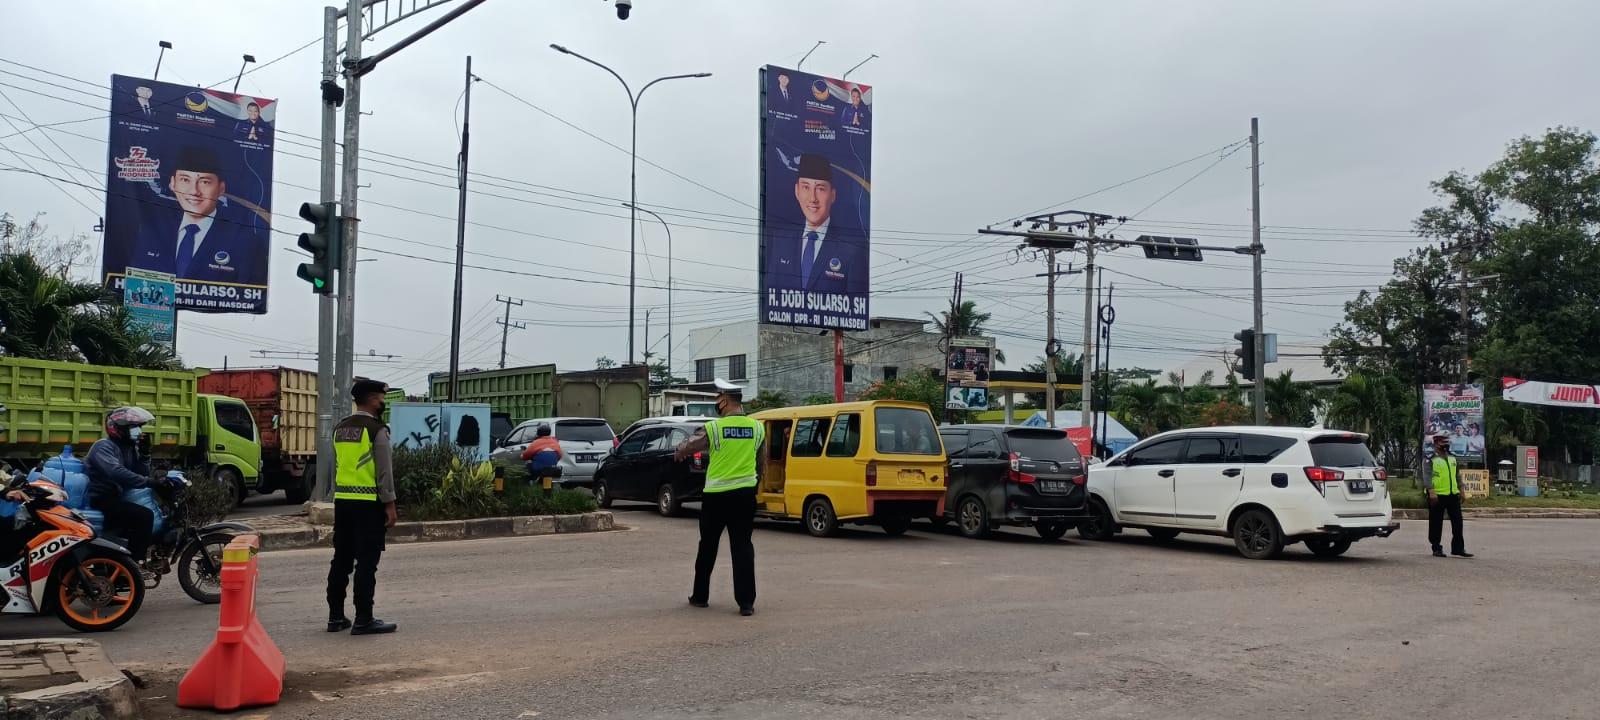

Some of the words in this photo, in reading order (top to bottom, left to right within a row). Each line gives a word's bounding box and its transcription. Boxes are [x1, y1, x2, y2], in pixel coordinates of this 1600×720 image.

[175, 282, 240, 300] SULARSO,
[244, 288, 262, 300] SH
[196, 299, 217, 307] DARI
[219, 301, 254, 309] NASDEM
[768, 288, 779, 306] H.
[781, 289, 804, 308] DODI
[807, 292, 851, 316] SULARSO,
[853, 297, 866, 314] SH
[768, 311, 791, 322] CALON
[794, 313, 808, 324] DPR
[813, 315, 820, 325] RI
[823, 315, 839, 326] DARI
[840, 317, 866, 329] NASDEM
[1551, 385, 1593, 402] JUMP
[724, 428, 753, 438] POLISI
[9, 537, 69, 578] REPSOL
